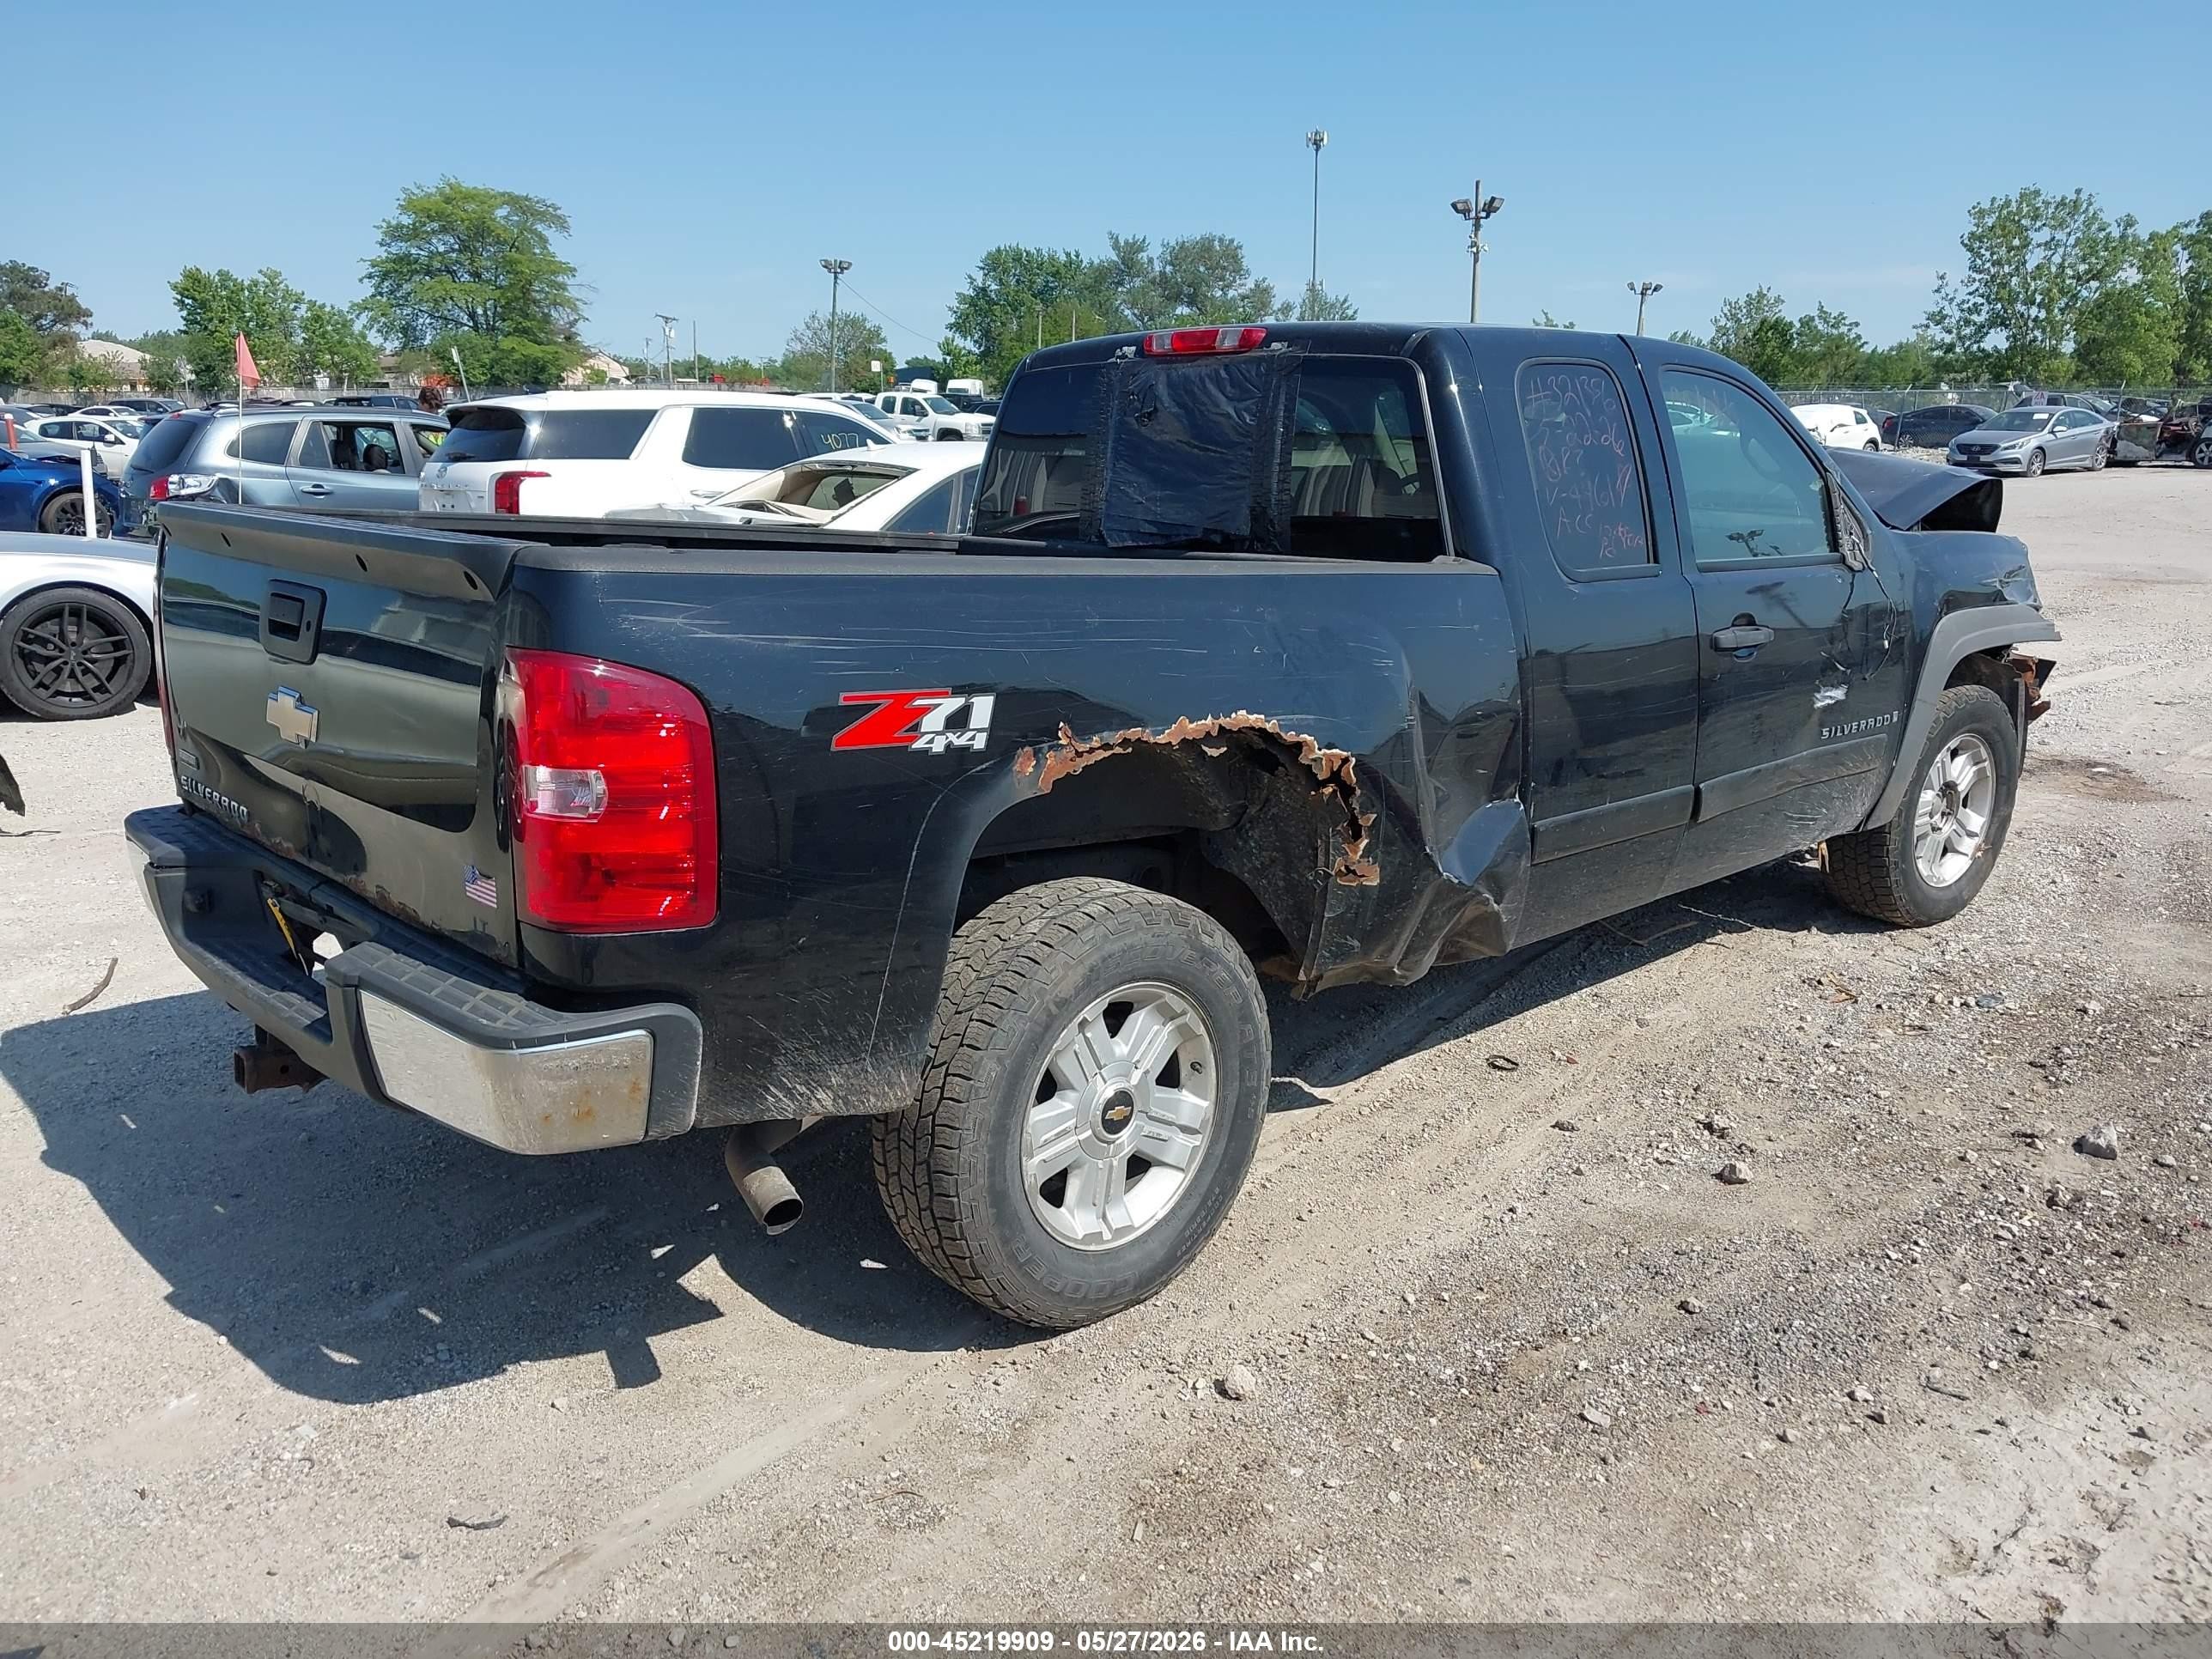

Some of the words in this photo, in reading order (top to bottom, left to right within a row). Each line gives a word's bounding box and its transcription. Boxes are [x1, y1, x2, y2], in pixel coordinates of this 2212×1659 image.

[820, 432, 860, 450] 4077
[830, 688, 996, 751] Z71
[1820, 714, 1891, 739] SILVERADO
[180, 775, 249, 823] SILVERADO
[1011, 1236, 1140, 1299] COOPER
